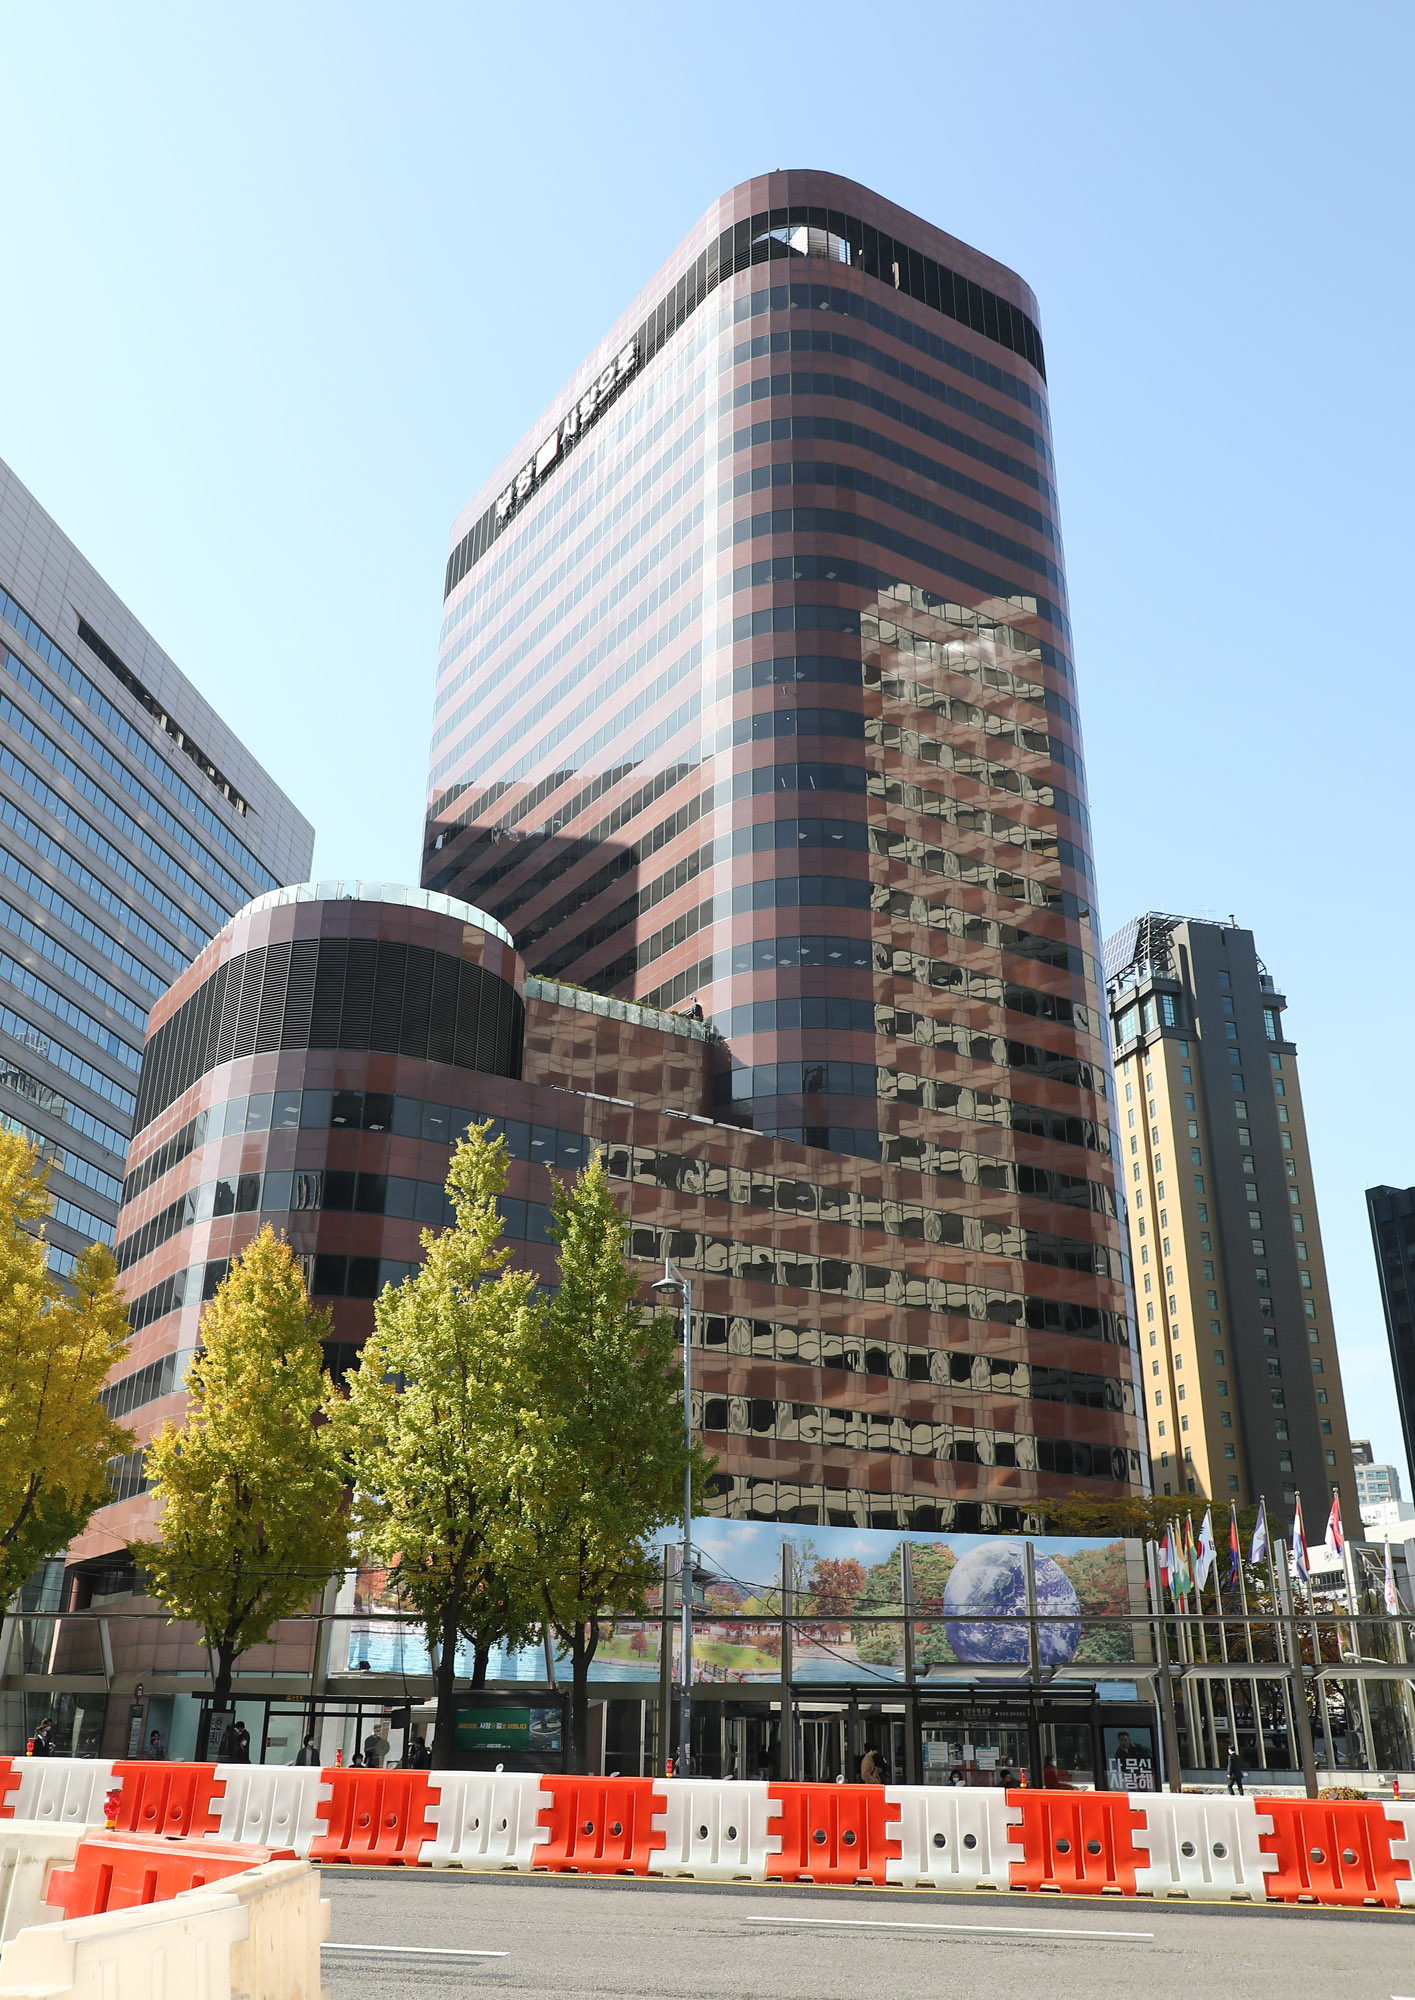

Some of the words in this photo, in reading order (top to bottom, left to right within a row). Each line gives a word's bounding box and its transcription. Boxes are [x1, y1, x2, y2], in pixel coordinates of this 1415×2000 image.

[496, 463, 533, 518] 부영
[560, 341, 635, 445] 사랑으로
[1108, 1757, 1123, 1774] 다
[1125, 1757, 1153, 1775] 무신
[1110, 1773, 1154, 1790] 사랑해
